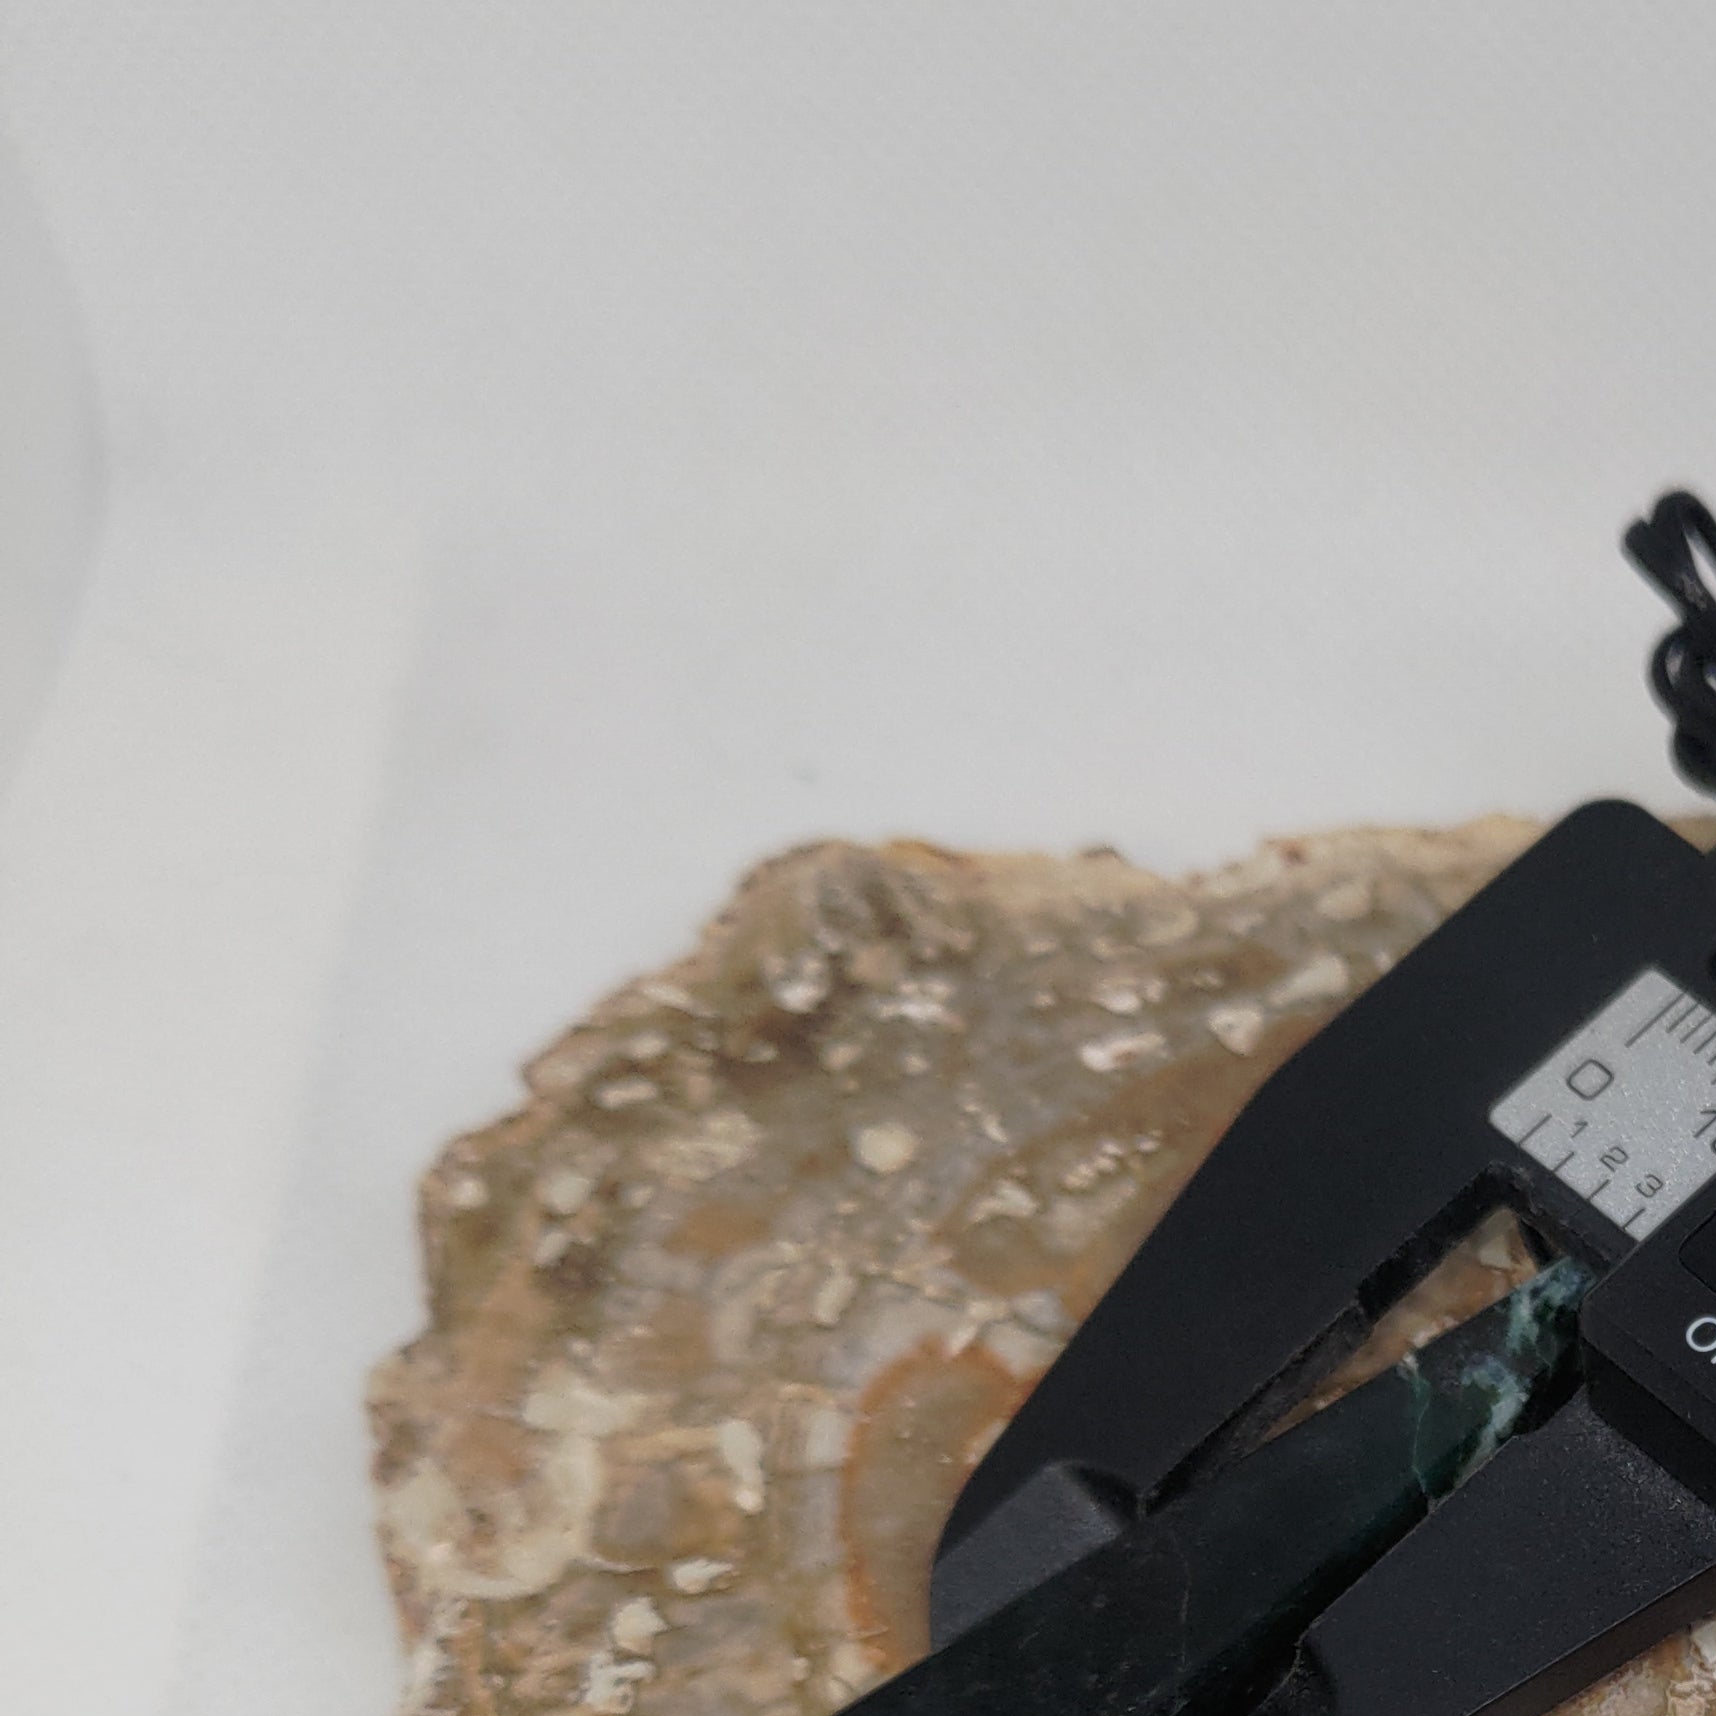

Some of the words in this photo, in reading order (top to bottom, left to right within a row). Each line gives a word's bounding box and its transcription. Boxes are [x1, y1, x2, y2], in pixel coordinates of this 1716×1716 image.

[1566, 1059, 1614, 1100] 0
[1570, 1120, 1588, 1138] 1
[1600, 1146, 1629, 1172] 2
[1635, 1173, 1664, 1198] 3
